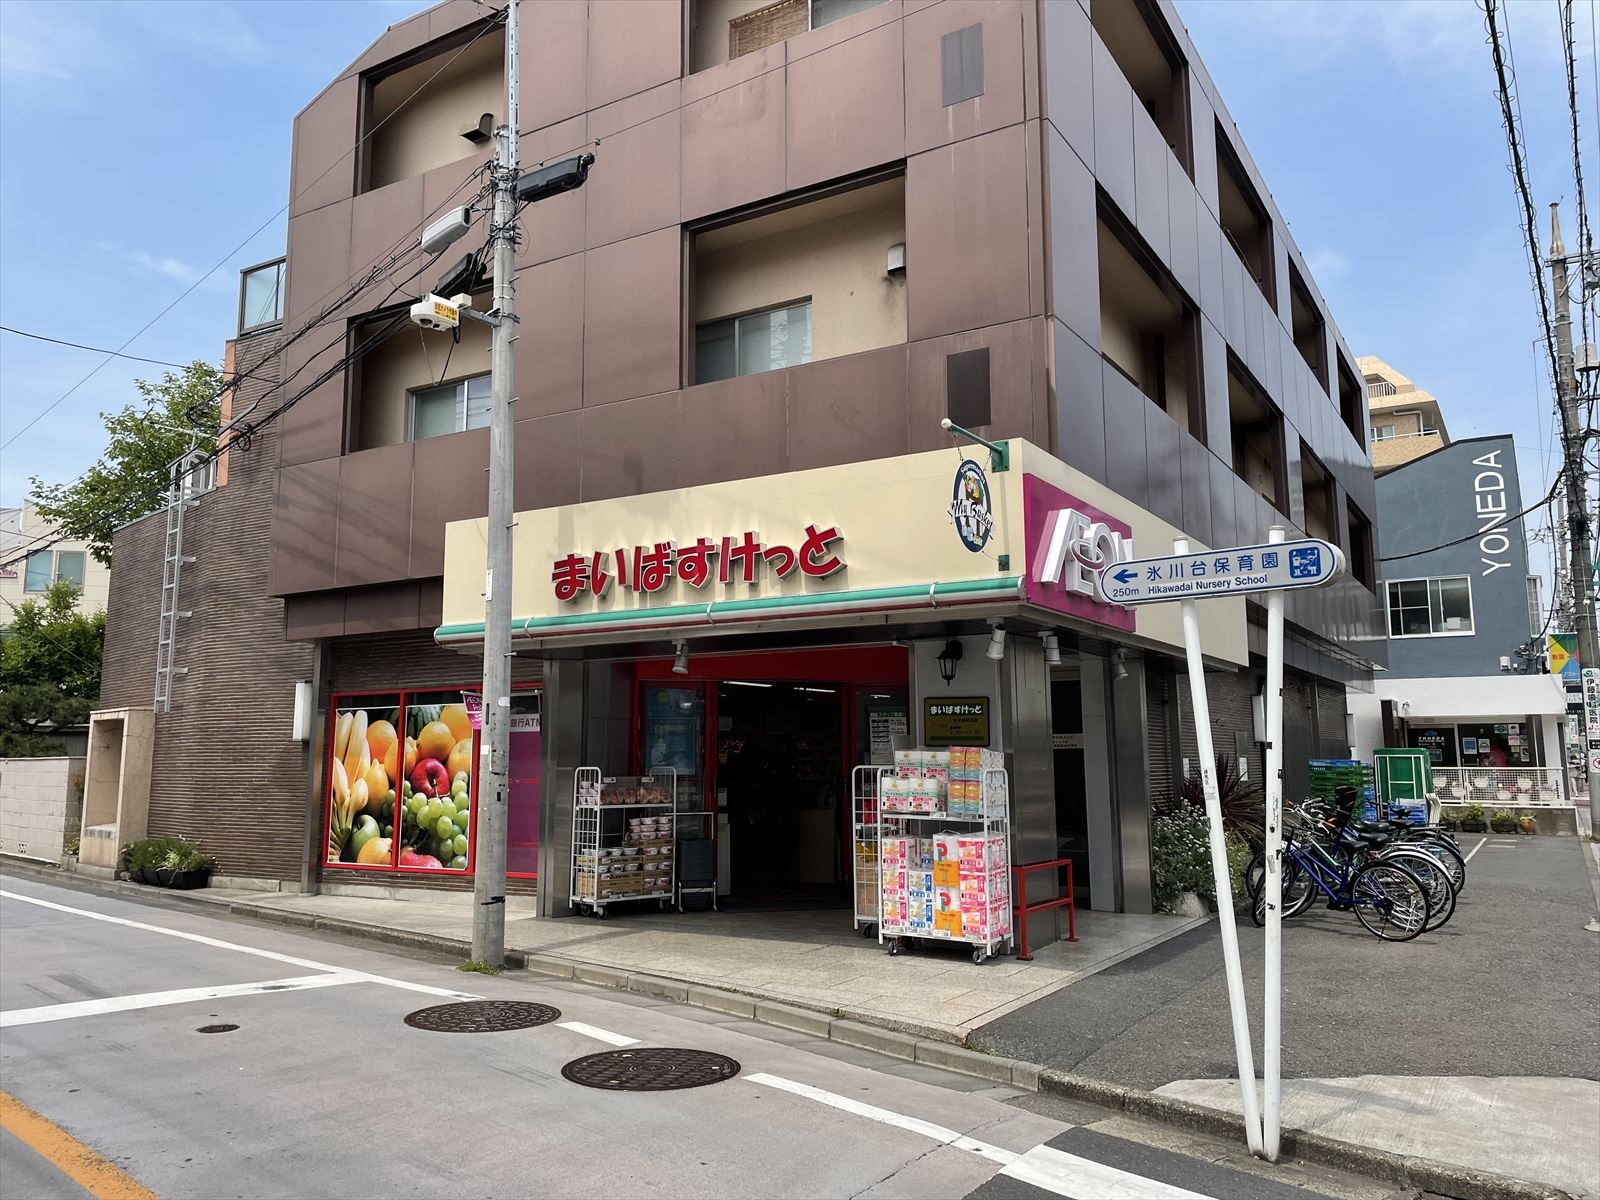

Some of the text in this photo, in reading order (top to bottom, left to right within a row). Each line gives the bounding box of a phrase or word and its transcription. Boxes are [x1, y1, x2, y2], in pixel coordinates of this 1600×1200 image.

[1472, 449, 1511, 576] YONEDA
[552, 524, 847, 602] まいばすけっと
[1146, 552, 1279, 582] 氷川台保育園
[1112, 574, 1268, 598] 250m Hikawadai Nursery School
[930, 705, 982, 715] まいばすけっと
